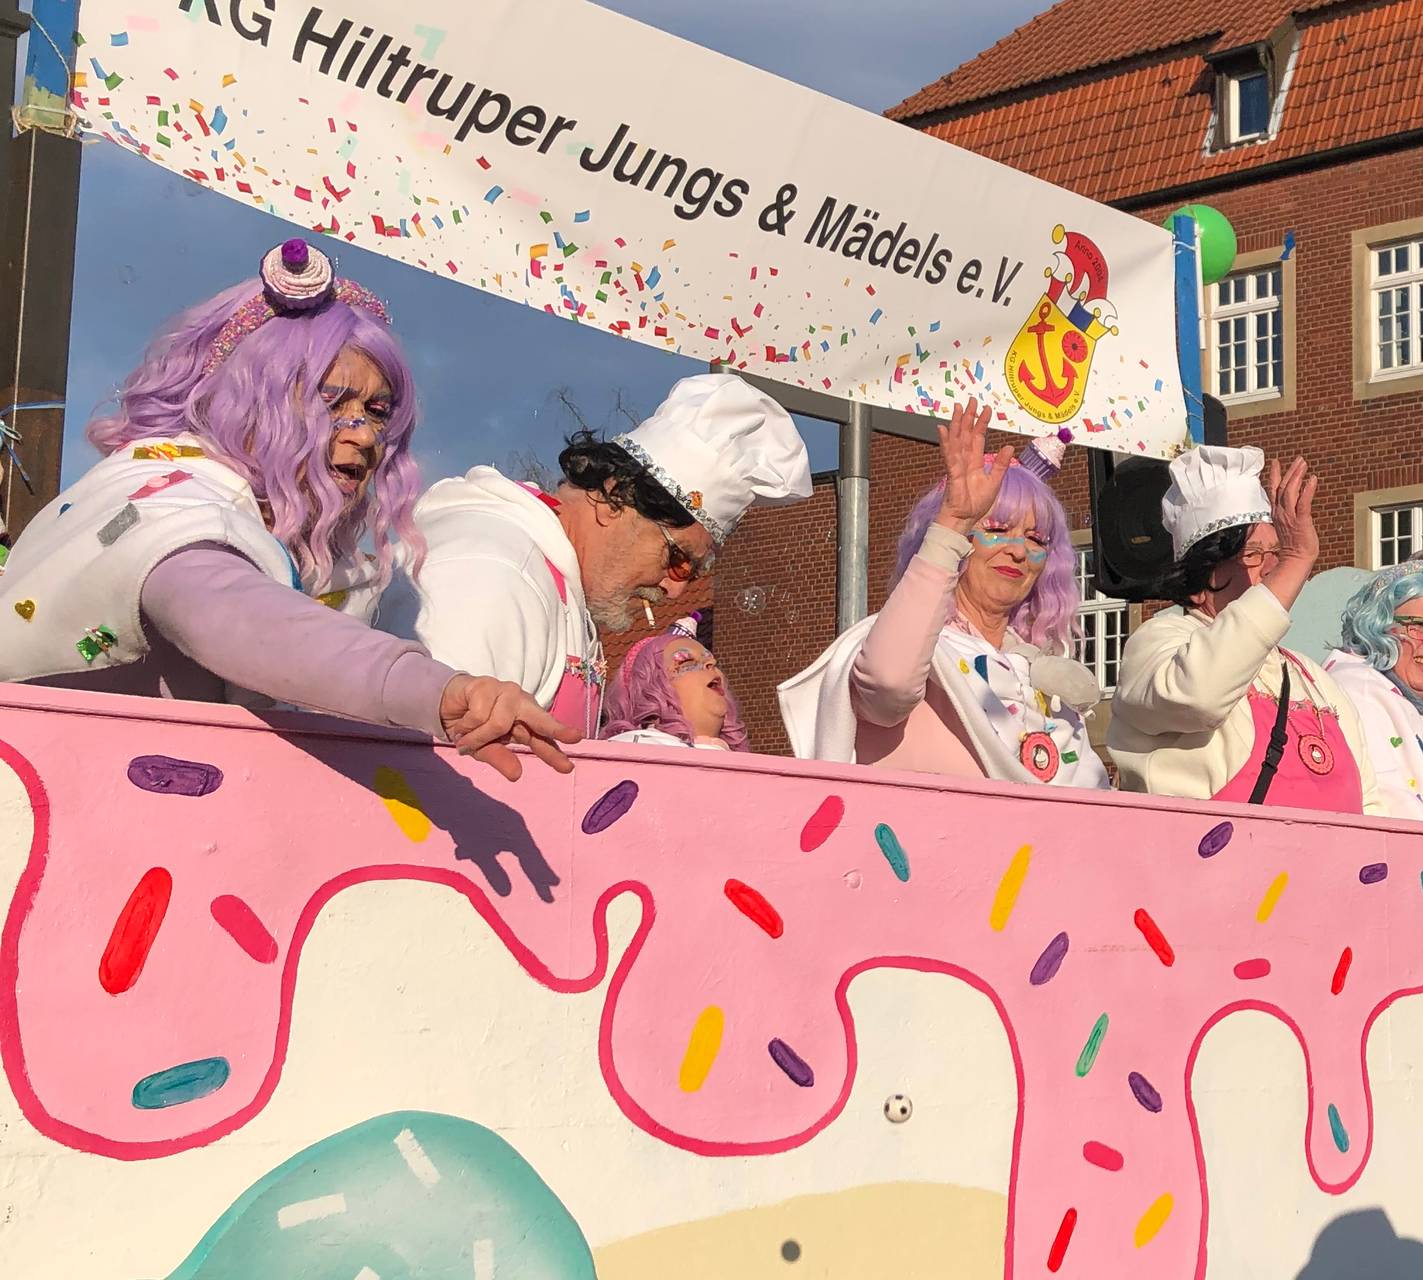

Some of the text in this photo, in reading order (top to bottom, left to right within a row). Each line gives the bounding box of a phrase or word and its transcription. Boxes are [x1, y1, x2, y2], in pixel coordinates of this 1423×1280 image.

[292, 6, 577, 154] Hiltruper
[579, 123, 750, 221] Jungs
[758, 183, 798, 237] &
[803, 196, 953, 285] Mädels
[956, 256, 1024, 307] e.V.
[1075, 240, 1093, 260] Anno
[1009, 350, 1018, 364] KG
[1008, 365, 1024, 401] Hiltruper
[1024, 401, 1046, 418] Jungs
[1048, 412, 1054, 420] &
